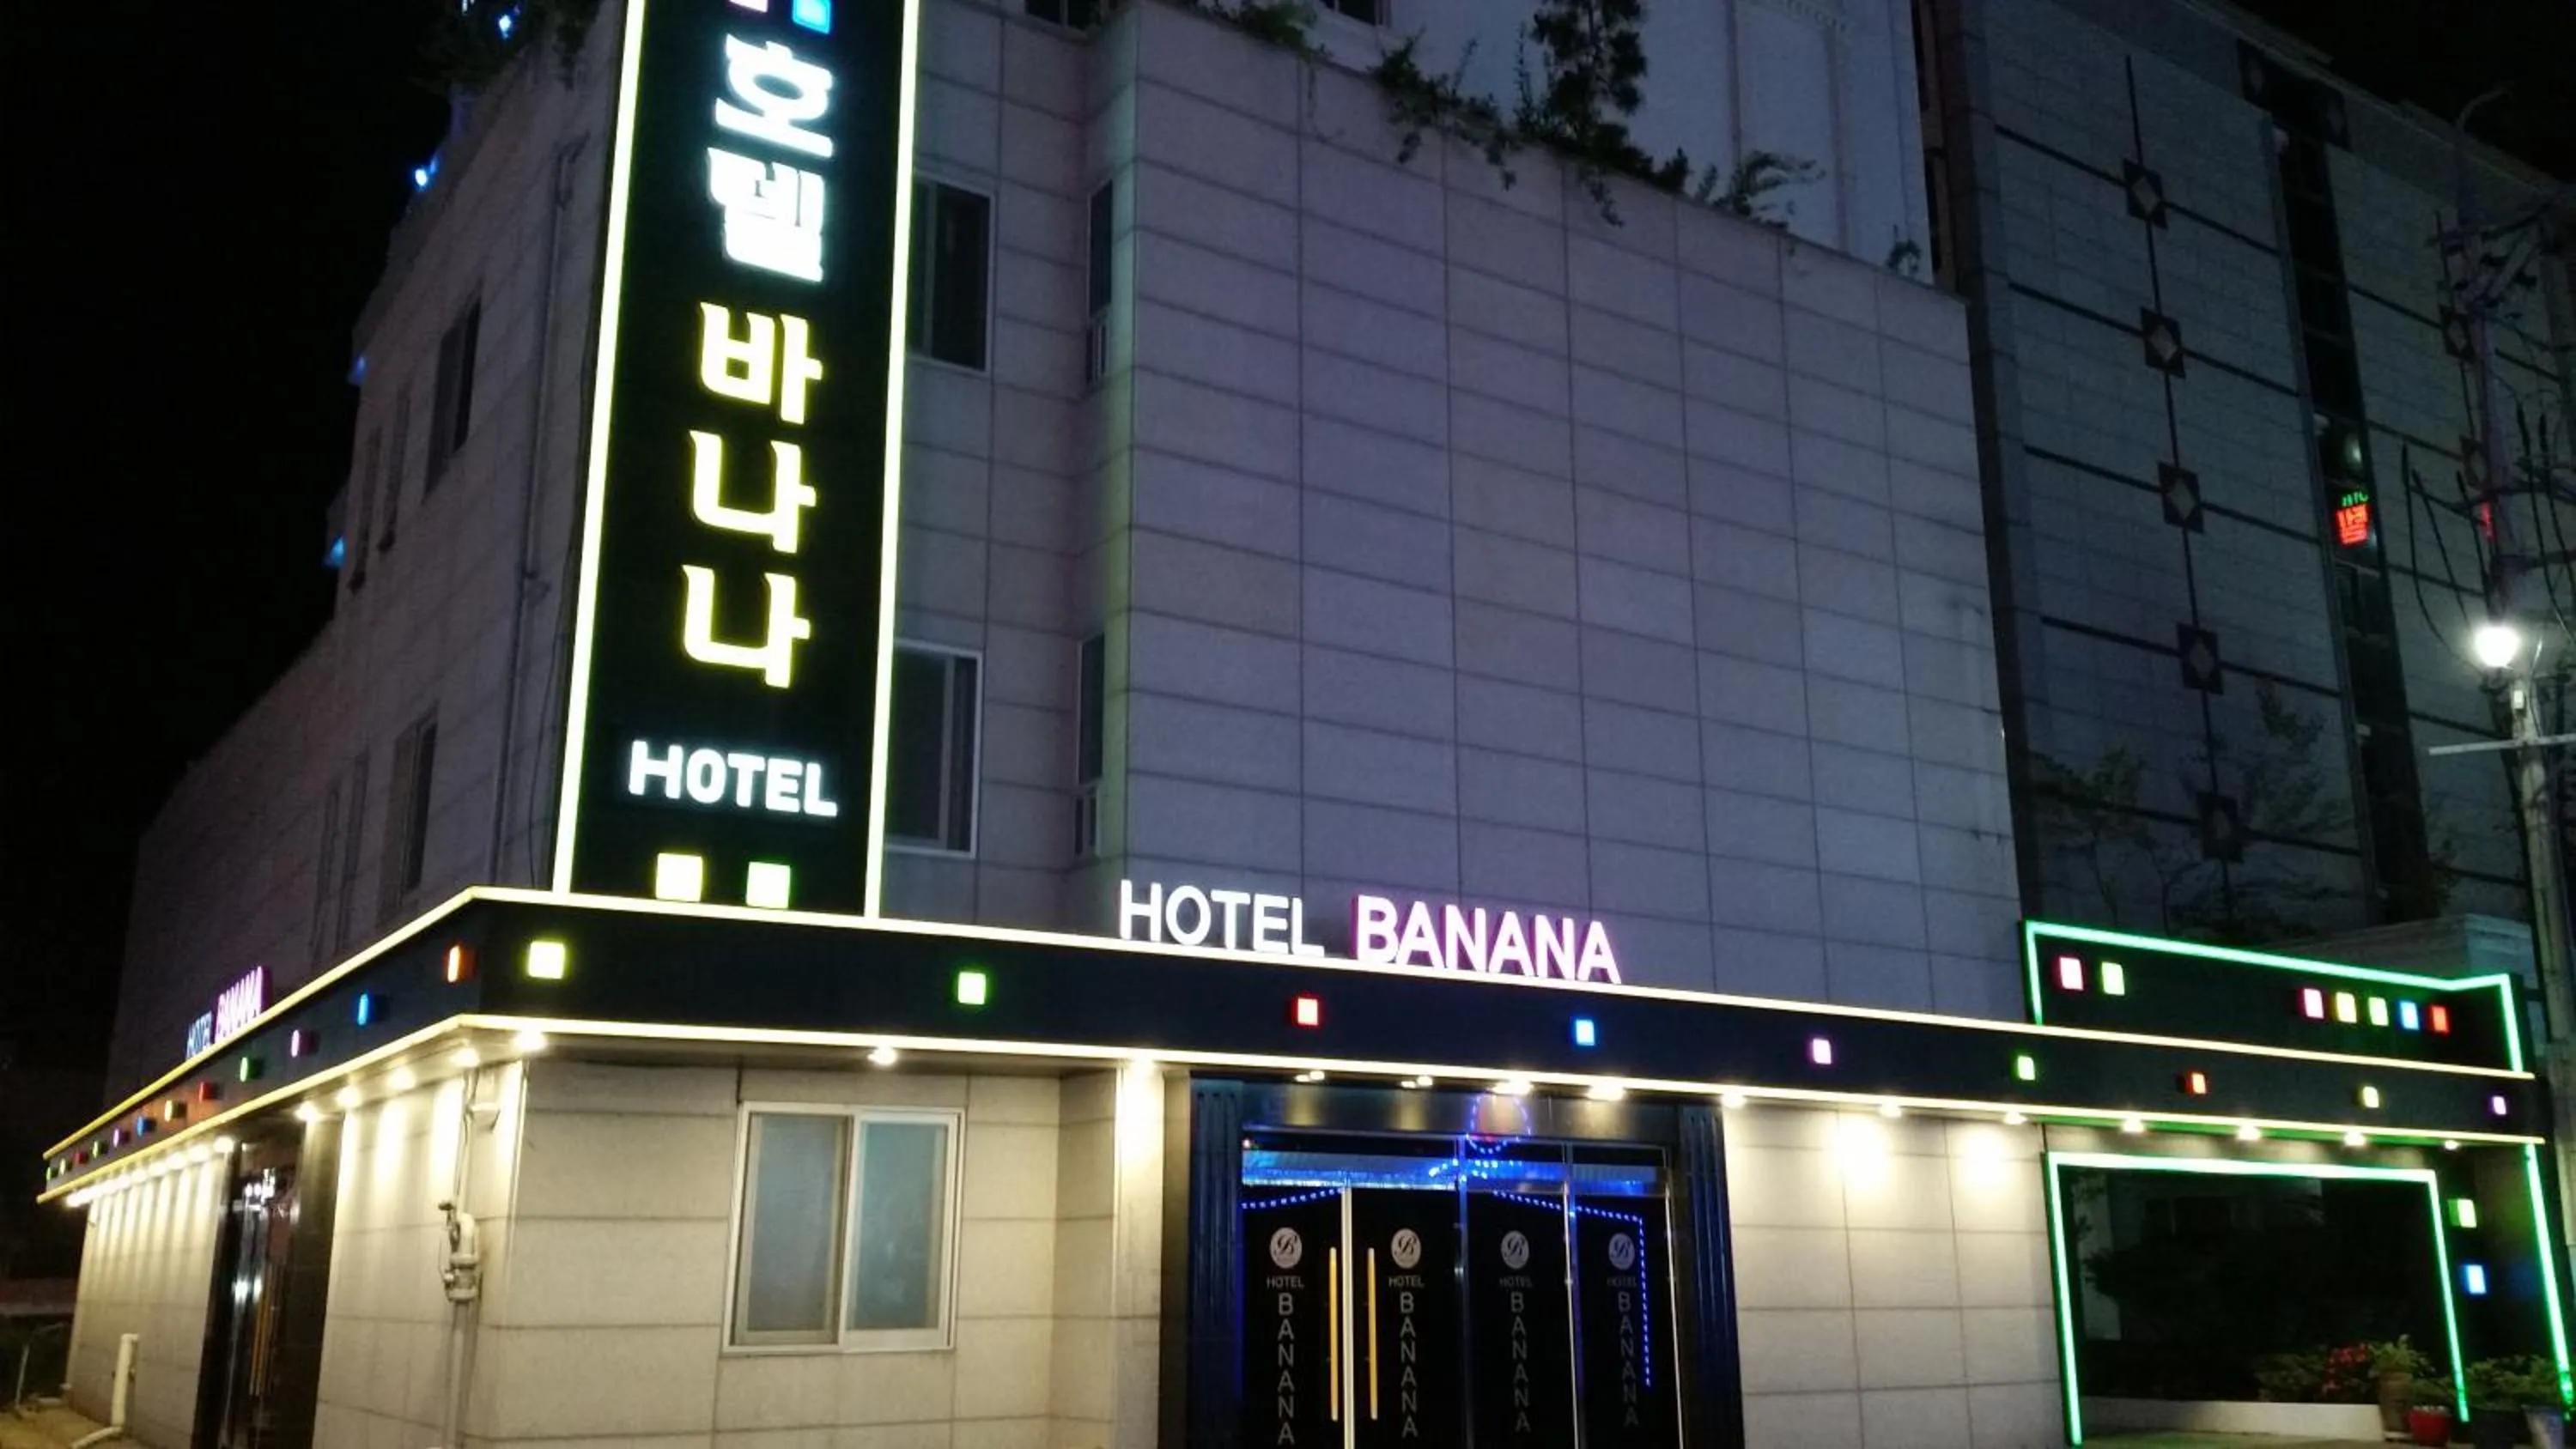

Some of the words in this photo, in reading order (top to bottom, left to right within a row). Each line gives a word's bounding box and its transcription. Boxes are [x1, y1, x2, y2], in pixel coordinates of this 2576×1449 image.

[708, 33, 833, 282] 호텔
[683, 302, 823, 688] 바나나
[628, 739, 838, 817] HOTEL
[1119, 879, 1324, 957] HOTEL
[1353, 894, 1622, 985] BANANA
[1267, 1276, 1304, 1289] HOTEL
[1388, 1276, 1425, 1288] HOTEL
[1277, 1292, 1295, 1446] BANANA
[1400, 1291, 1419, 1438] BANANA
[1510, 1291, 1531, 1433] BANANA
[1618, 1291, 1639, 1428] BANANA
